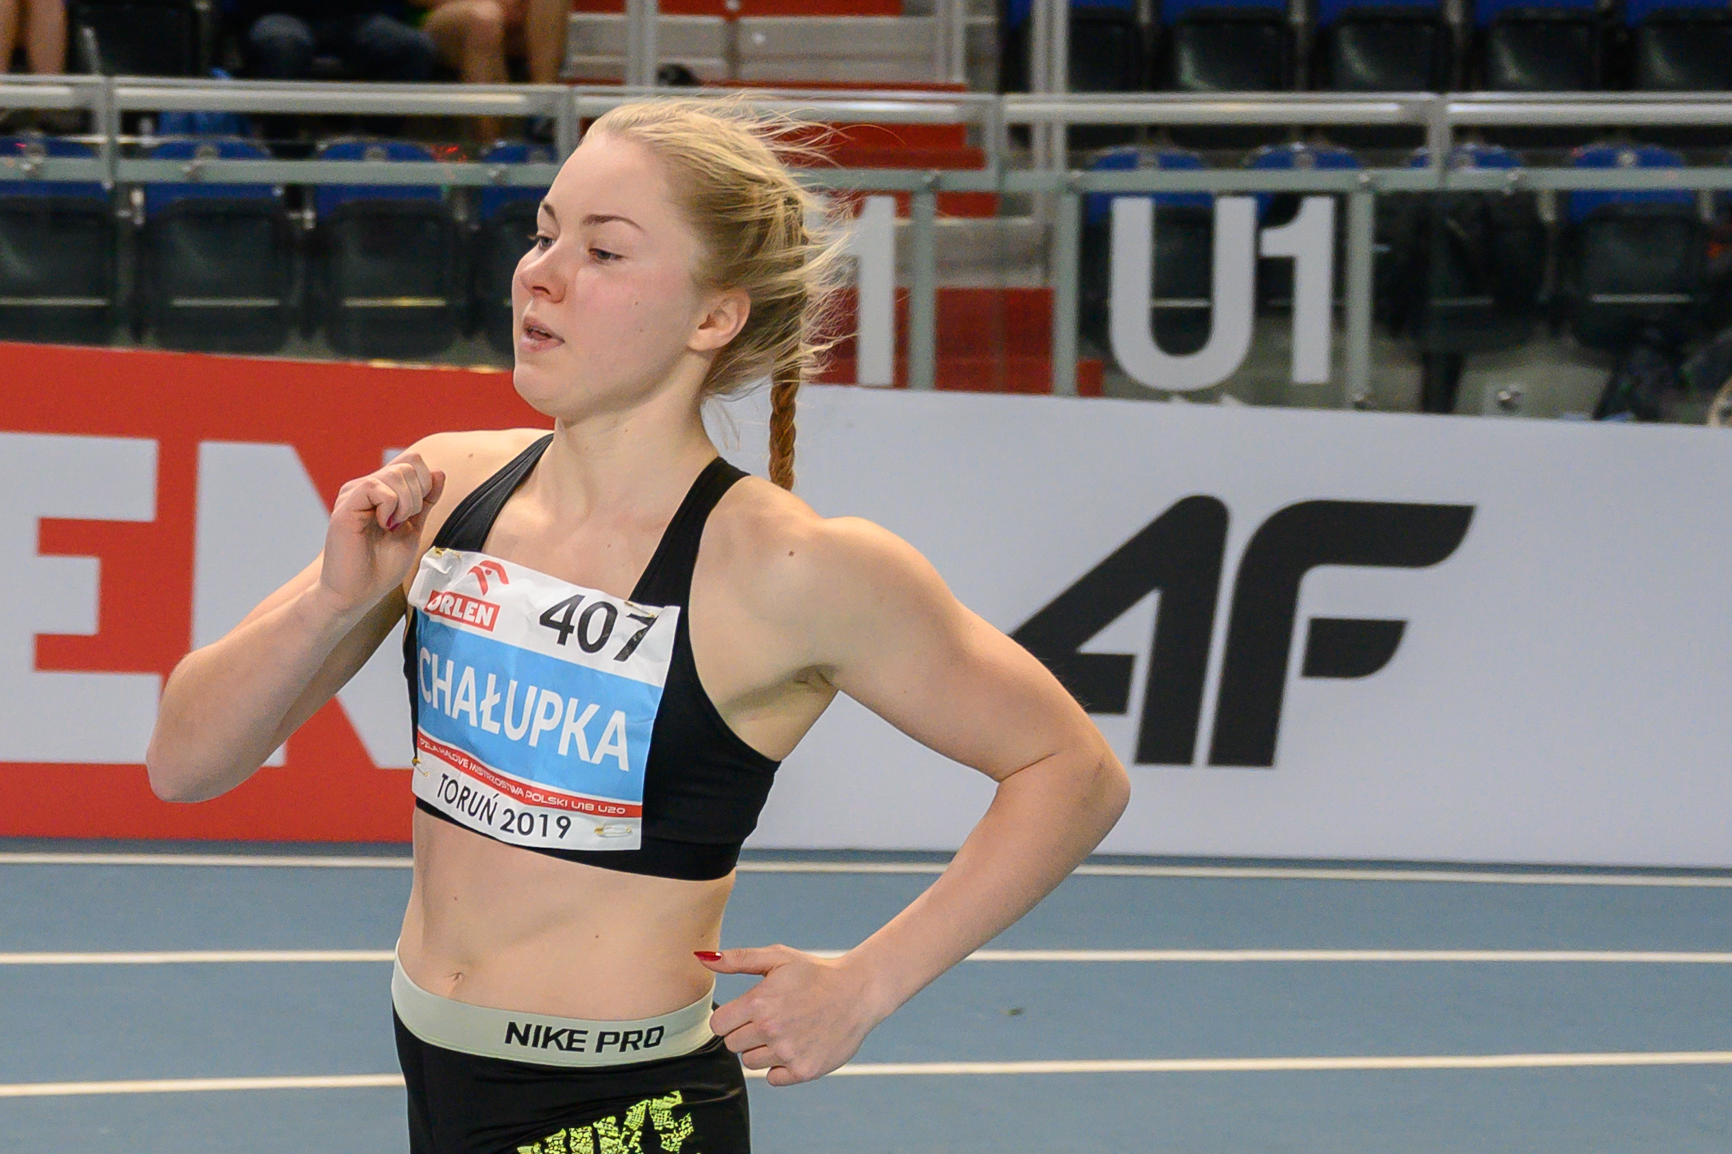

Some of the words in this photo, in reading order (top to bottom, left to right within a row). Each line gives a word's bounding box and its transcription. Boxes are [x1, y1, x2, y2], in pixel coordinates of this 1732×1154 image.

[1109, 195, 1336, 391] U1
[427, 594, 495, 627] ORLEN
[539, 594, 659, 662] 407
[418, 647, 630, 772] CHAŁUPKA
[437, 773, 498, 826] TORUŃ
[500, 808, 572, 840] 2019
[524, 790, 568, 807] POLSKI
[571, 800, 595, 812] U18
[597, 805, 626, 815] U20
[504, 1021, 588, 1053] NIKE
[595, 1025, 665, 1054] PRO
